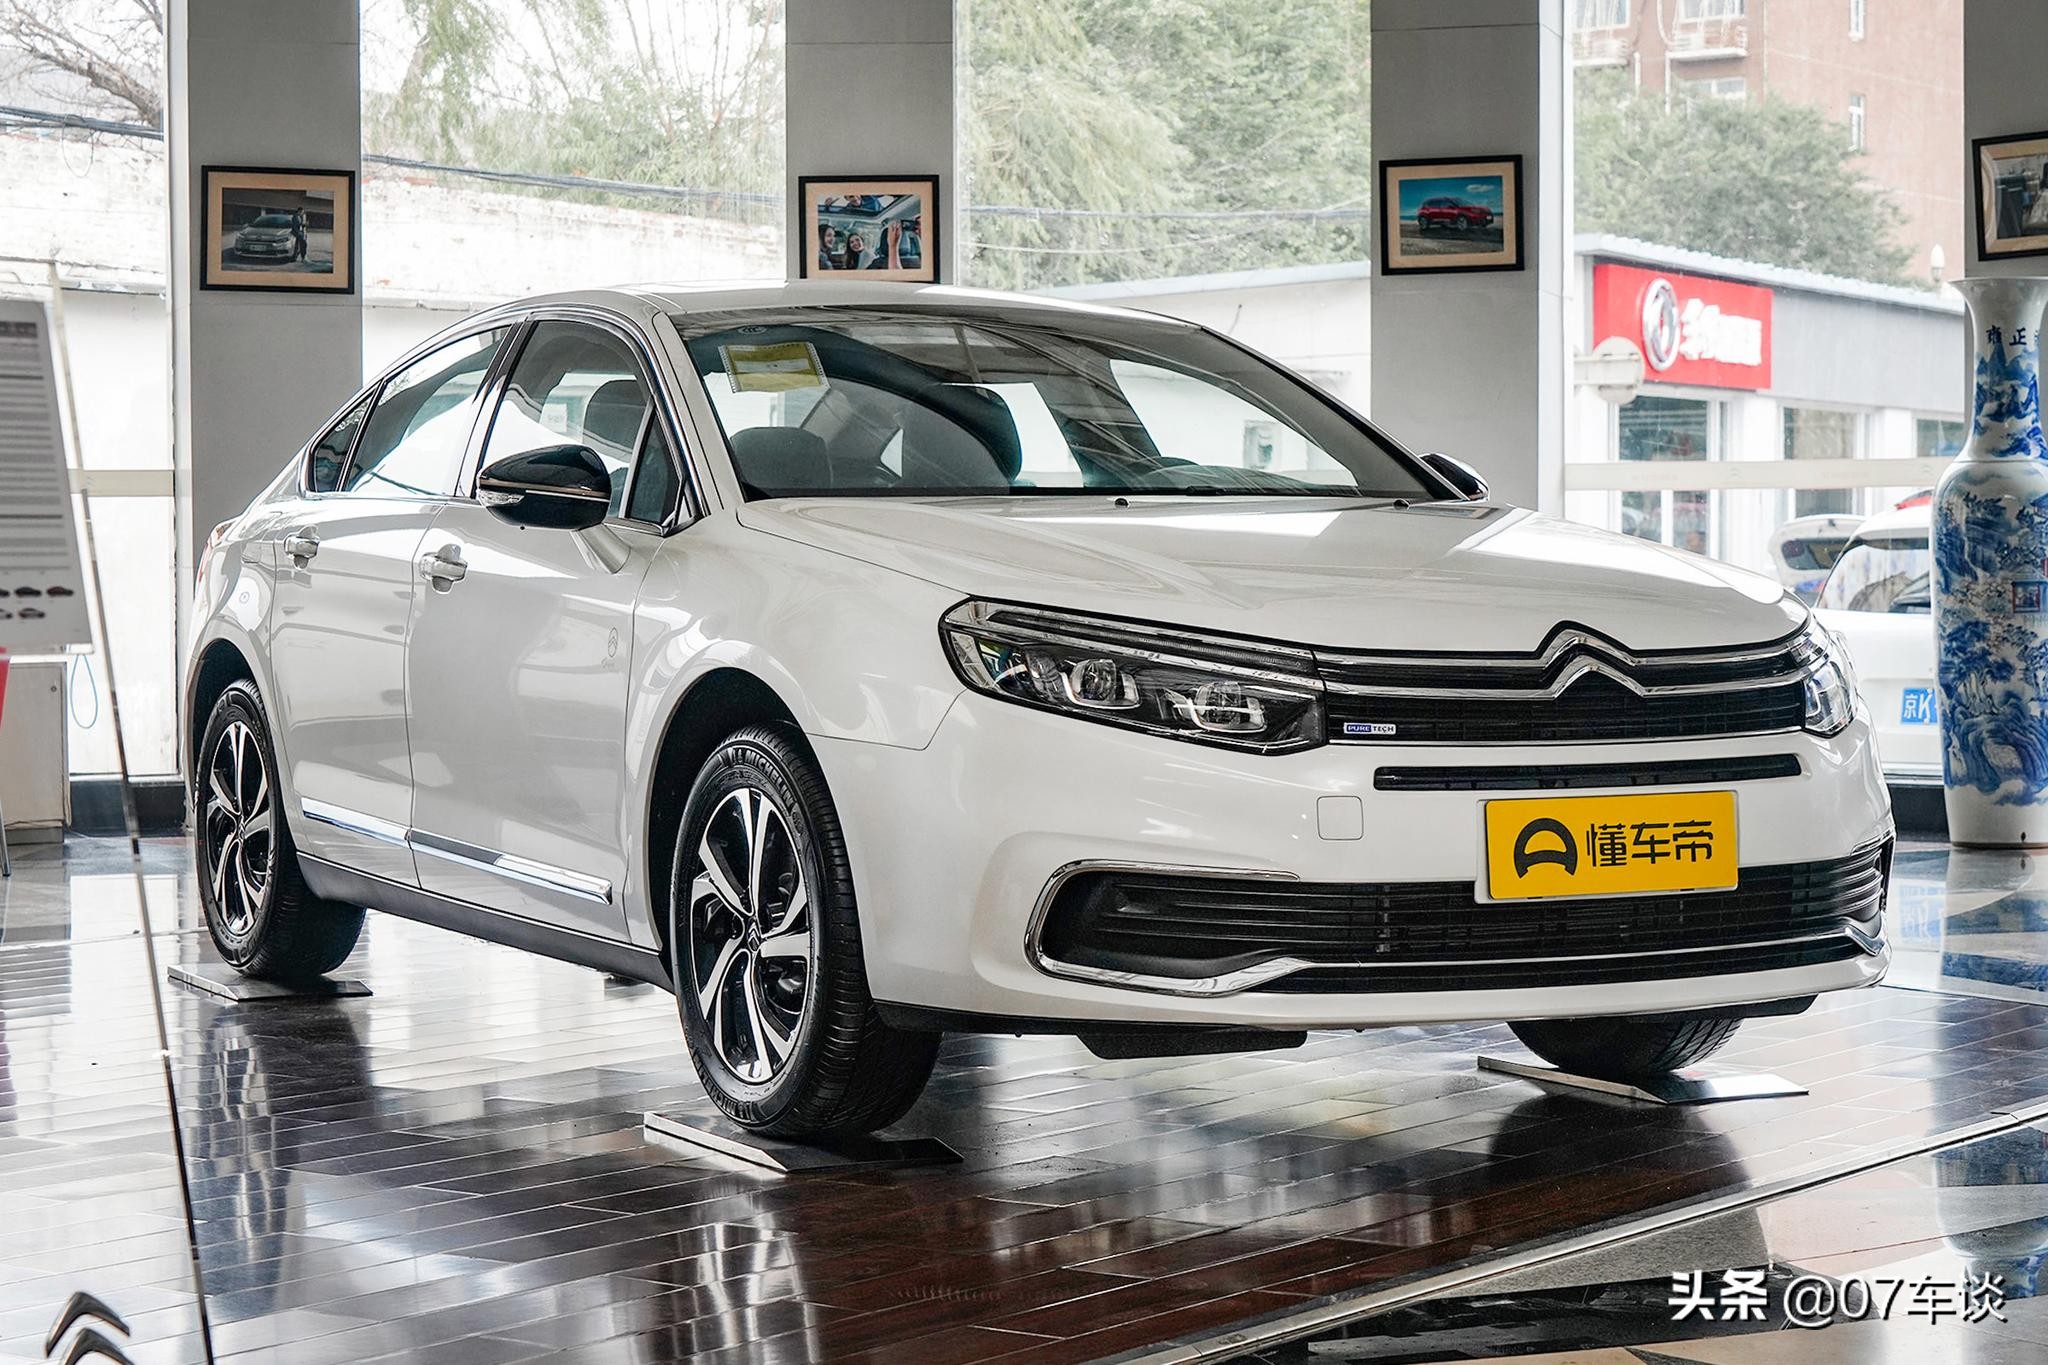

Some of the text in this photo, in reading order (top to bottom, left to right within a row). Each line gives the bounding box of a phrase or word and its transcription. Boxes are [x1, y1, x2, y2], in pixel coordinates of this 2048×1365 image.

[744, 749, 796, 811] MICHELIN
[1586, 820, 1714, 867] 懂车帝
